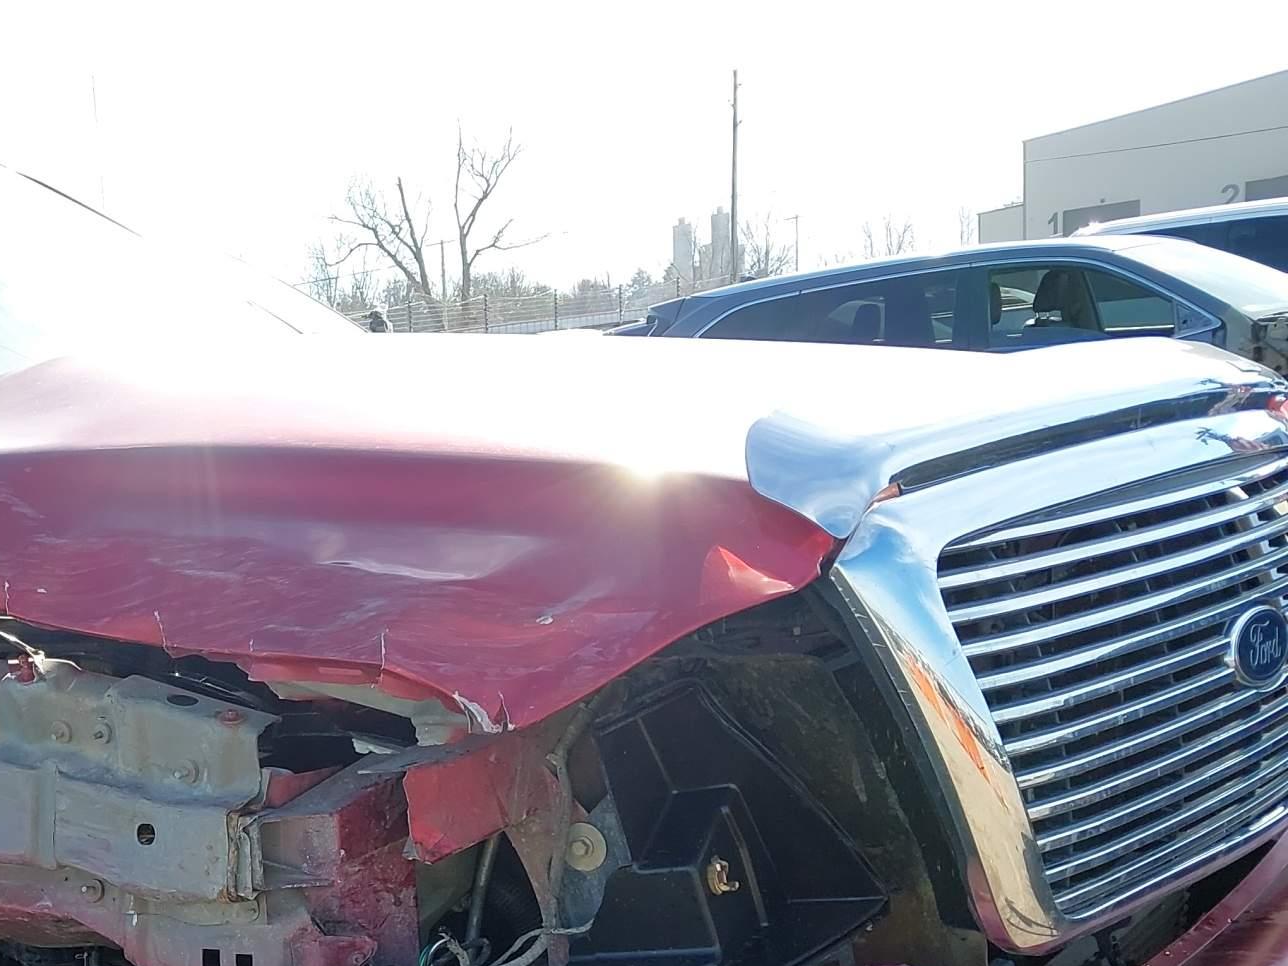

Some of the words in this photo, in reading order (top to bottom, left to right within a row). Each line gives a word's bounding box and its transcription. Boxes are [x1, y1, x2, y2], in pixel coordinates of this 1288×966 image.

[1220, 184, 1240, 205] 2
[1047, 211, 1059, 236] 1
[1249, 620, 1282, 666] Ford
